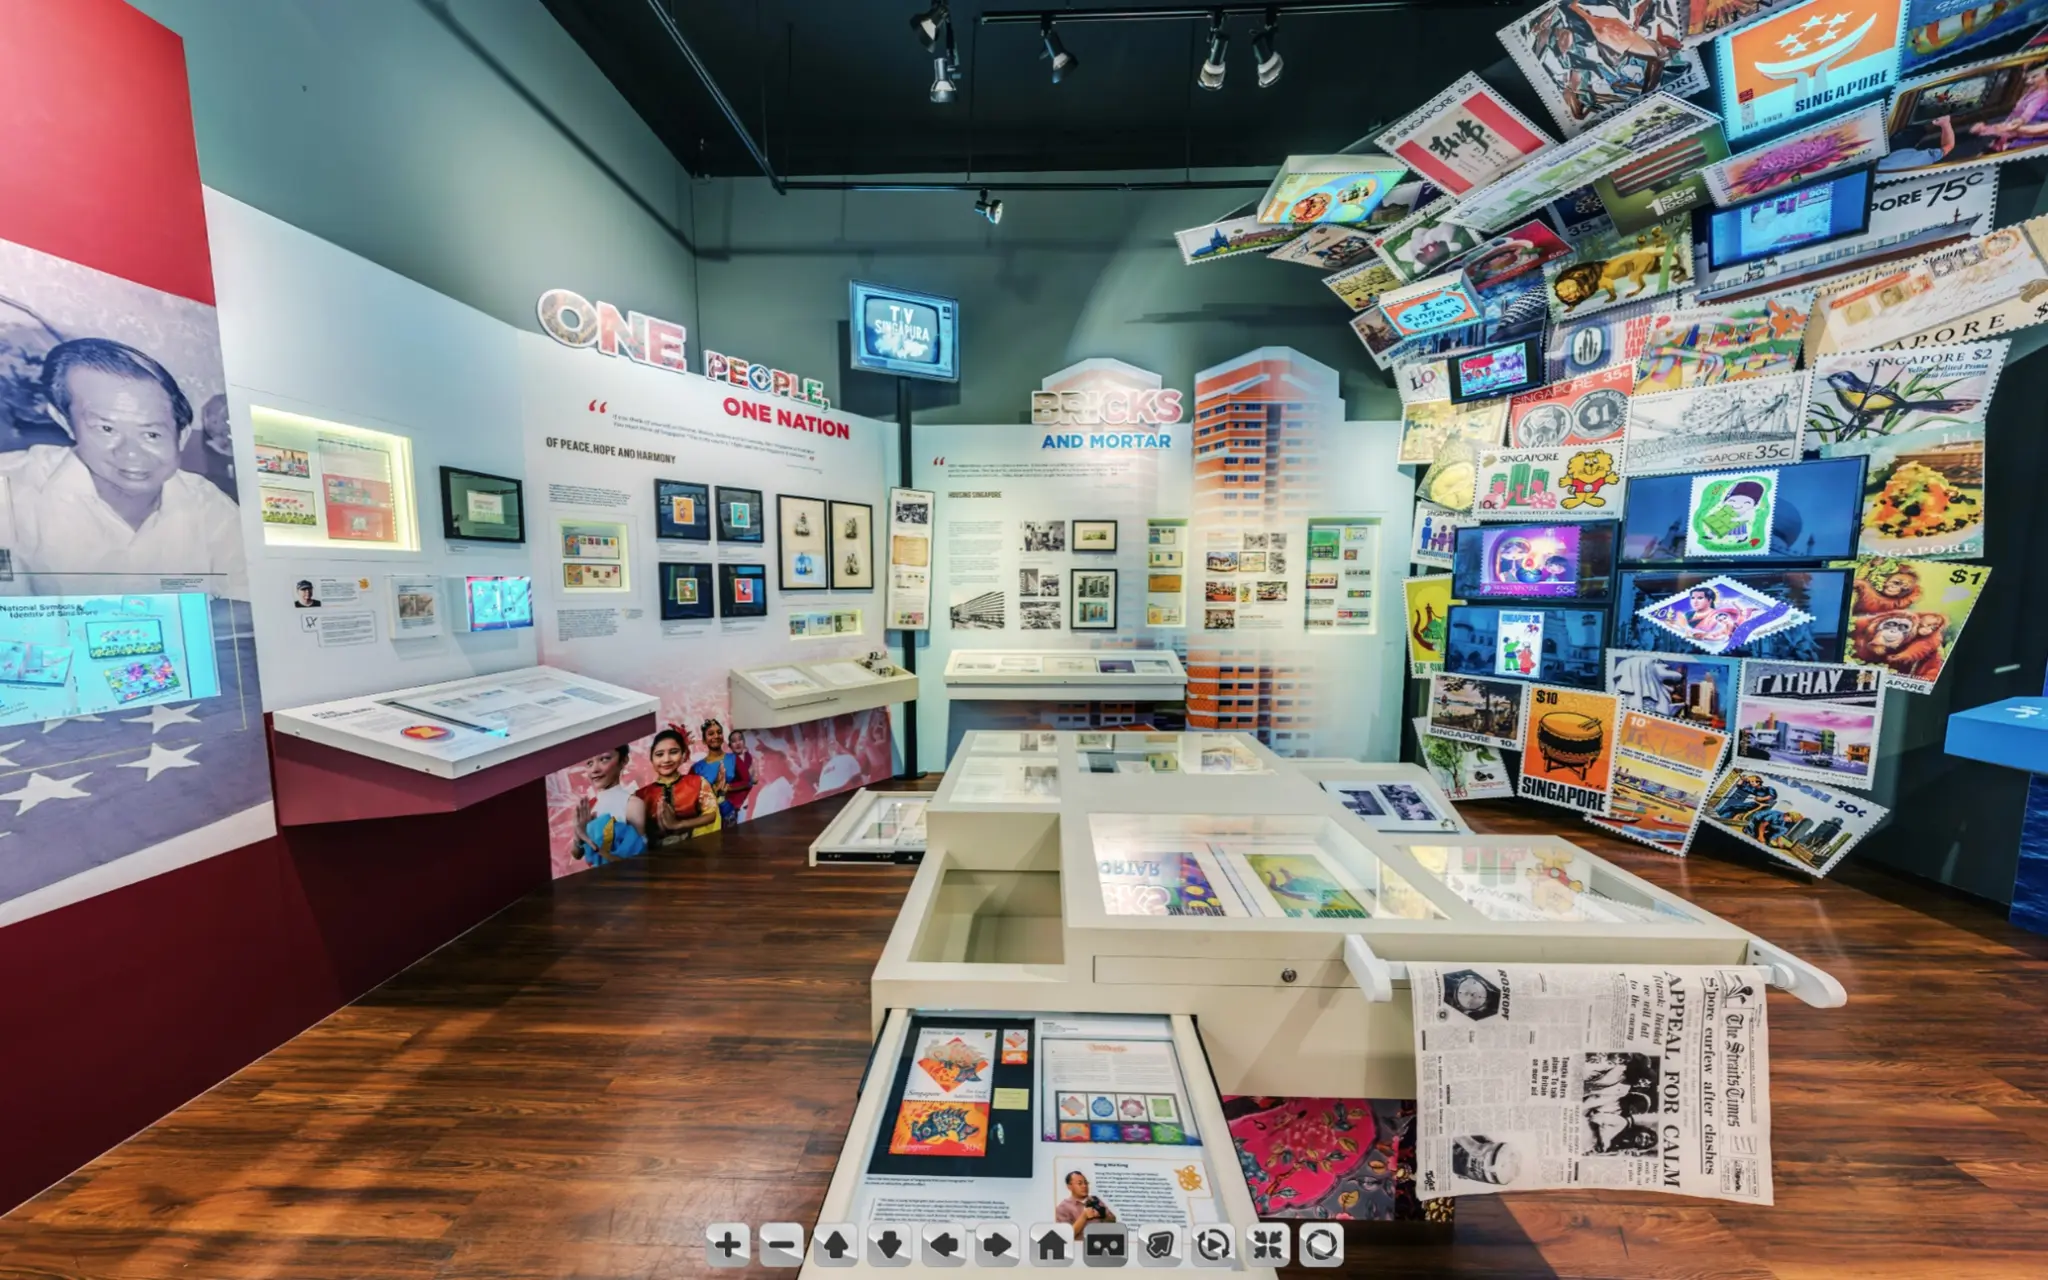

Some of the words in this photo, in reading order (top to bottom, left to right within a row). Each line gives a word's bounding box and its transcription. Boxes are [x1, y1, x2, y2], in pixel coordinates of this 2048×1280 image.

[1795, 69, 1889, 113] SINGAPORE
[1397, 95, 1457, 138] SINGAPORE
[1458, 82, 1475, 96] $2
[1922, 247, 1968, 265] Stamps
[1419, 302, 1433, 312] I
[1435, 297, 1456, 307] am
[537, 289, 687, 374] ONE
[875, 319, 930, 342] SINGAPURA
[1867, 352, 1966, 368] SINGAPORE
[1972, 349, 1993, 361] $2
[704, 350, 831, 413] PEOPLE,
[1513, 378, 1595, 408] SINGAPORE
[723, 397, 772, 424] ONE
[777, 408, 850, 440] NATION
[1031, 388, 1184, 426] BRICKS
[546, 437, 559, 449] OF
[593, 443, 616, 457] HOPE
[618, 447, 636, 459] AND
[636, 449, 676, 464] HARMONY
[1042, 434, 1083, 450] AND
[1089, 433, 1172, 451] MORTAR
[1682, 452, 1753, 466] SINGAPORE
[1755, 445, 1790, 460] 35c
[1500, 453, 1559, 463] SINGAPORE
[1950, 569, 1983, 586] $1
[0, 604, 37, 612] National
[39, 604, 75, 612] Symbols
[1536, 690, 1558, 705] $10
[1430, 728, 1491, 743] SINGAPORE
[1522, 777, 1606, 811] SINGAPORE
[1835, 800, 1868, 818] 50¢
[1497, 969, 1511, 1021] ROSKOPF
[1630, 980, 1638, 990] to
[1643, 984, 1650, 997] we
[1653, 975, 1665, 1007] Razak:
[1703, 976, 1717, 1020] S'pore
[1631, 995, 1640, 1008] the
[1641, 1001, 1651, 1018] will
[1627, 1013, 1637, 1041] enemy
[1653, 1013, 1665, 1045] Divided
[1664, 971, 1684, 1061] APPEAL
[1725, 1014, 1745, 1038] The
[1640, 1022, 1650, 1039] fall
[1703, 1027, 1715, 1076] curfew
[1725, 1040, 1745, 1087] Straits
[1541, 1060, 1549, 1072] with
[1531, 1086, 1539, 1096] aid
[1663, 1071, 1680, 1113] FOR
[1704, 1082, 1715, 1117] after
[1725, 1088, 1745, 1127] Times
[1663, 1125, 1681, 1189] CALM
[1704, 1124, 1717, 1175] clashes
